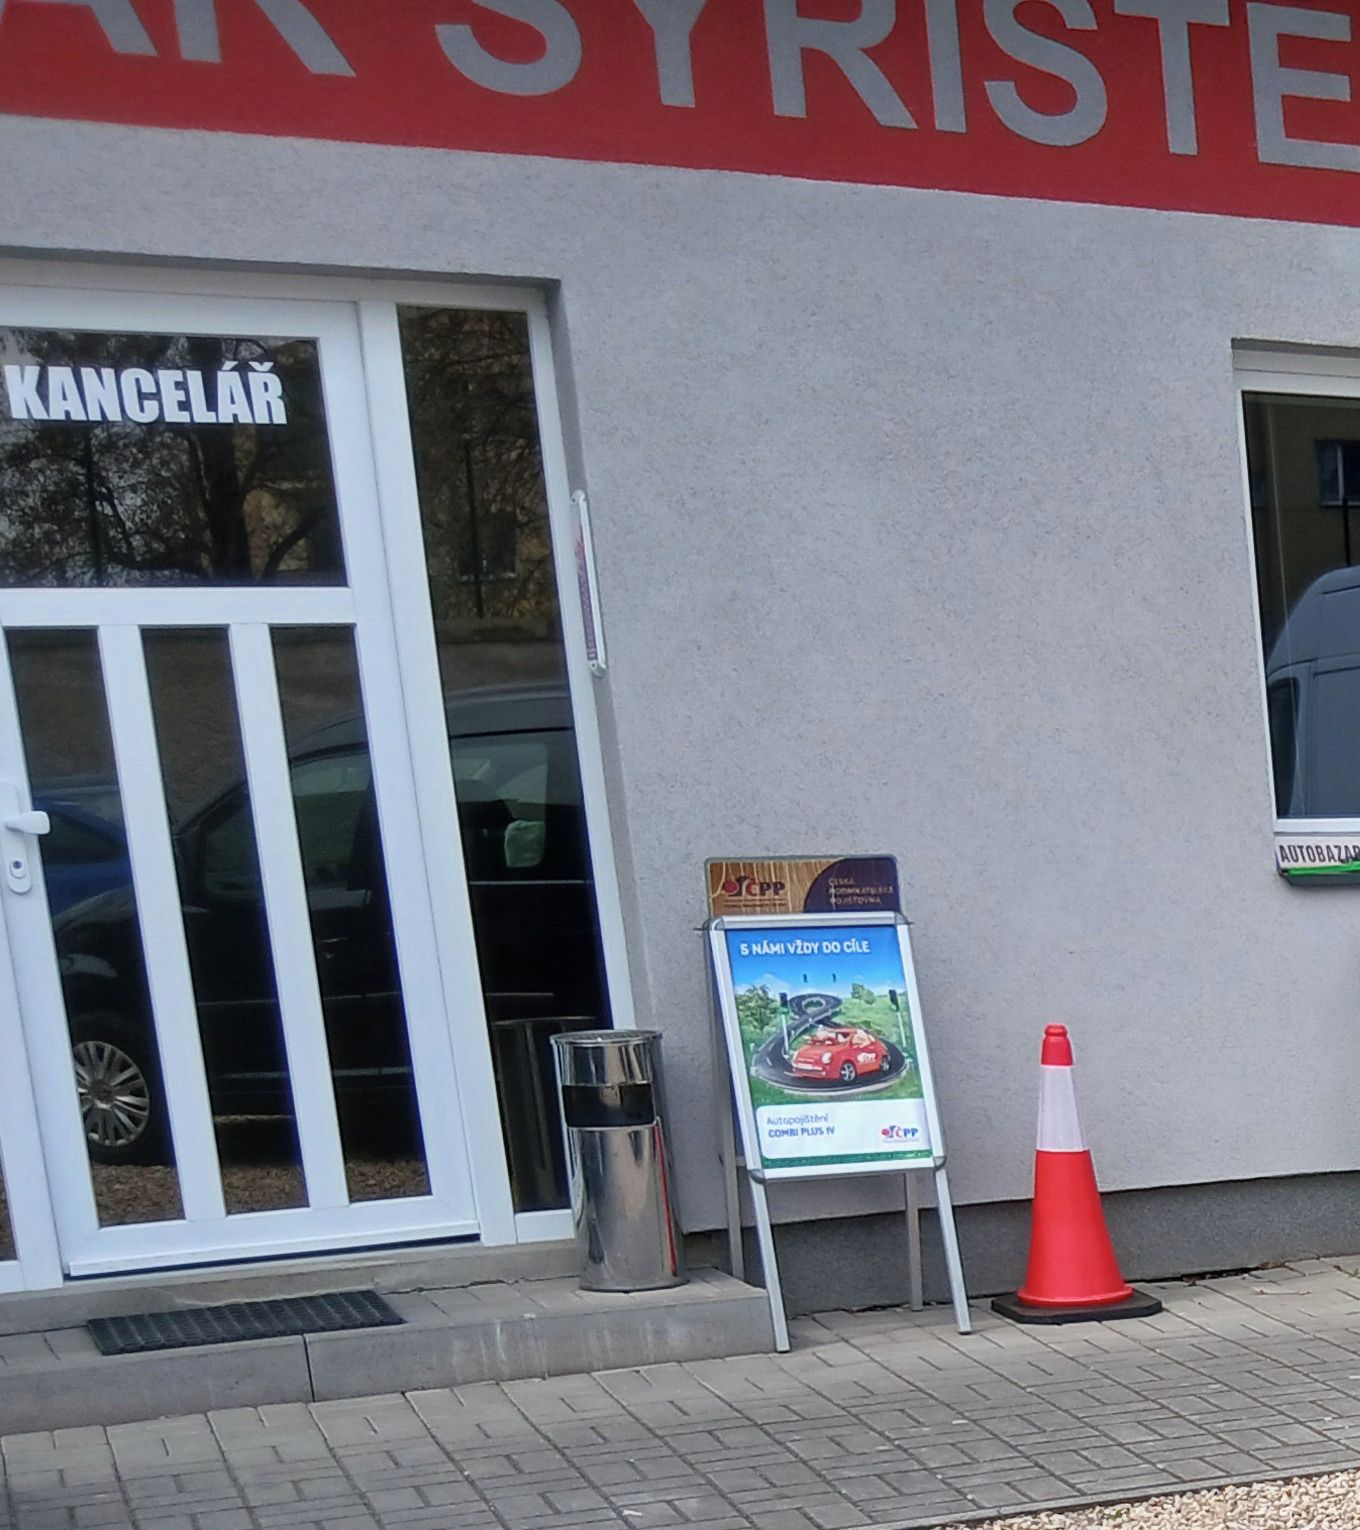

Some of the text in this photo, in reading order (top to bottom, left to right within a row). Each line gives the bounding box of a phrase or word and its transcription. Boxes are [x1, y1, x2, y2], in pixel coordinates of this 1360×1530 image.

[4, 361, 287, 425] KANCELÁŘ
[740, 938, 870, 955] S NÁMI VŽDY DO CÍLE
[768, 1128, 799, 1139] COMBI
[801, 1127, 824, 1137] PLUS
